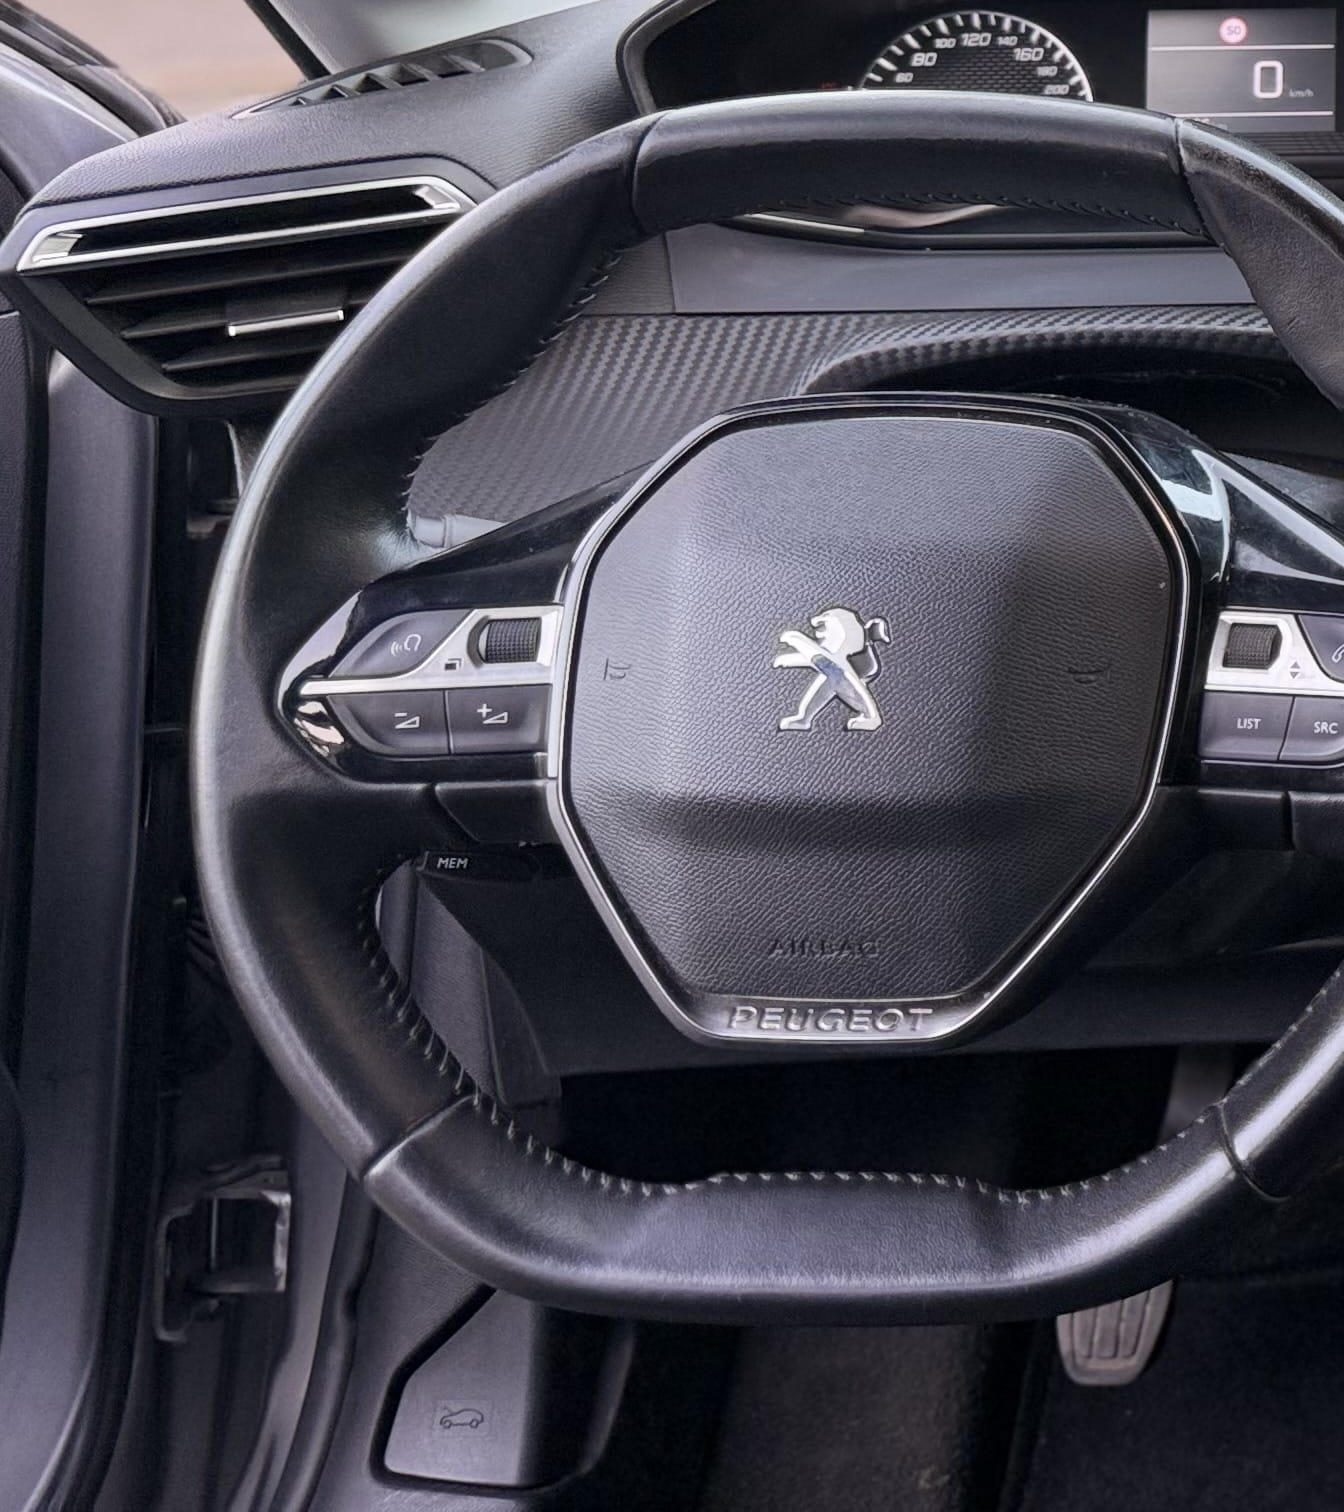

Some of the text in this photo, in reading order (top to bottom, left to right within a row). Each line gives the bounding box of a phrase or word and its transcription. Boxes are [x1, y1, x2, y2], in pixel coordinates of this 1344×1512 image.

[933, 38, 956, 49] 100
[960, 32, 992, 47] 120
[997, 36, 1018, 47] 140
[911, 52, 937, 67] 80
[1013, 47, 1044, 62] 160
[1253, 60, 1314, 99] 0 km/h
[1044, 84, 1070, 95] 200
[1236, 717, 1262, 731] LIST
[1313, 720, 1339, 735] SRC
[436, 856, 469, 870] MEM
[768, 939, 881, 958] AIRBAG
[728, 1005, 934, 1033] PEUGEOT
